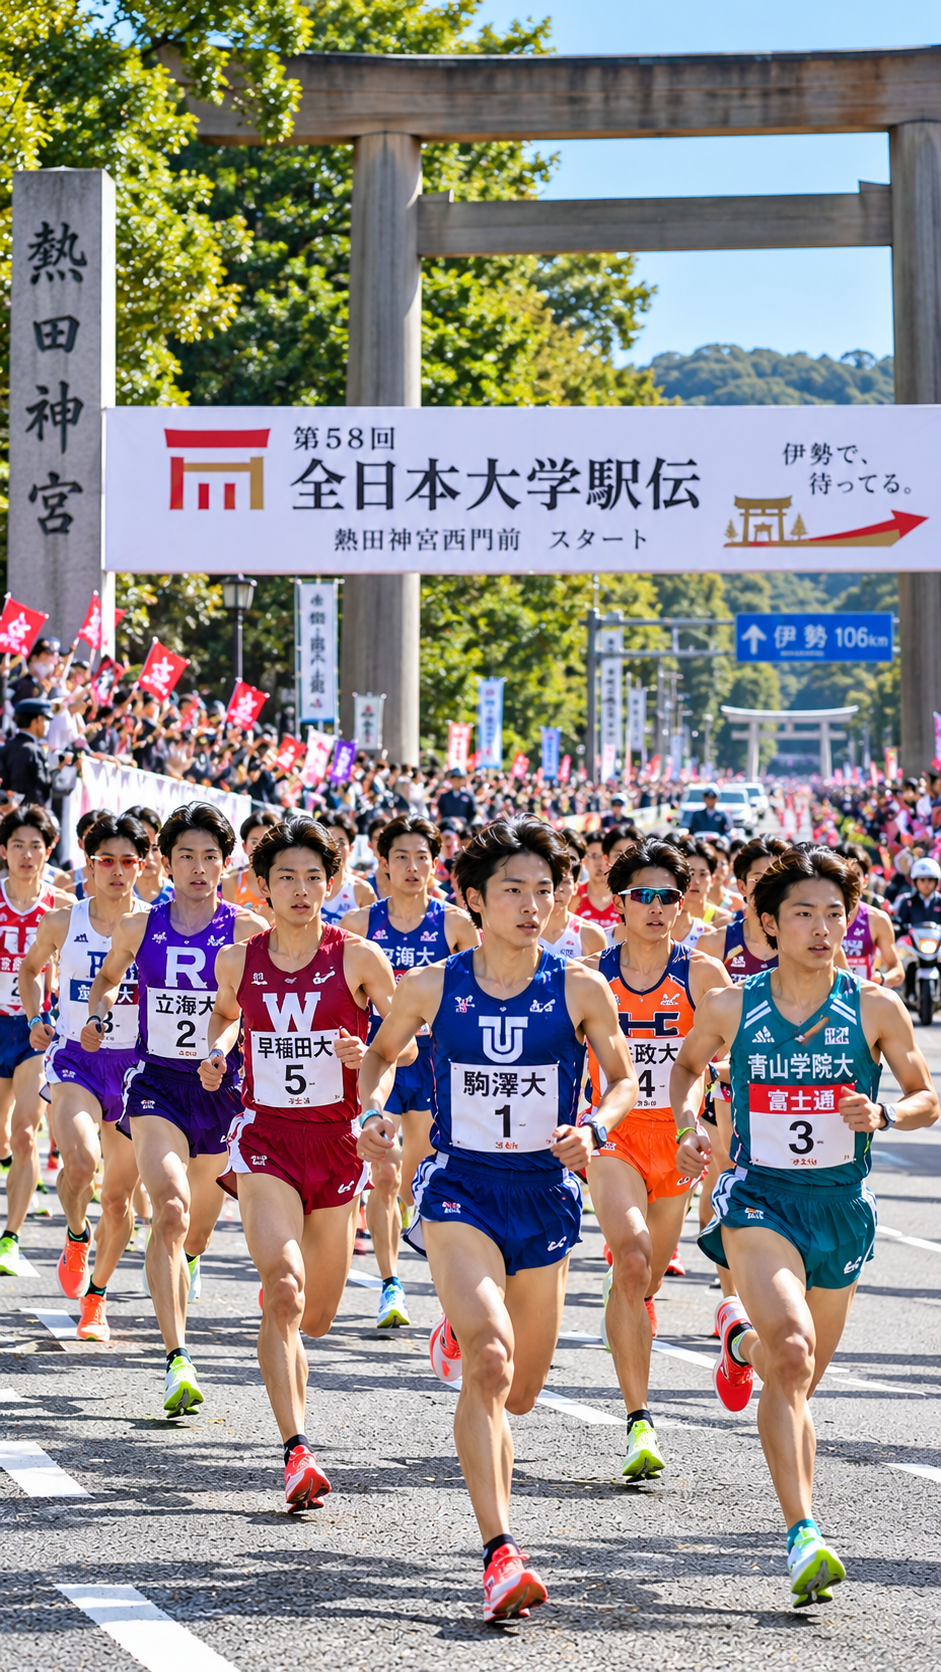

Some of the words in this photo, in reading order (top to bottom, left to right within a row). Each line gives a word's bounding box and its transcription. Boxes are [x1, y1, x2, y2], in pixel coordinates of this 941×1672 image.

[27, 221, 87, 536] 熱田神宮
[293, 426, 396, 451] 第58回
[783, 442, 868, 466] 伊勢で、
[290, 457, 700, 511] 全日本大学駅伝
[810, 472, 912, 496] 待ってる。
[334, 528, 520, 552] 熱田神宮西門前
[549, 529, 647, 550] スタート
[774, 624, 828, 649] 伊勢
[835, 626, 889, 648] 106km
[164, 946, 208, 989] R
[262, 992, 321, 1032] W
[175, 1020, 196, 1048] 2
[257, 1036, 334, 1060] 早稲田大
[630, 1043, 678, 1065] 政大
[748, 1053, 854, 1080] 青山学院大
[284, 1064, 307, 1096] 5
[463, 1070, 546, 1098] 駒澤大
[638, 1069, 656, 1098] 4
[767, 1089, 836, 1112] 富士通
[494, 1104, 511, 1138] 1
[788, 1120, 814, 1155] 3
